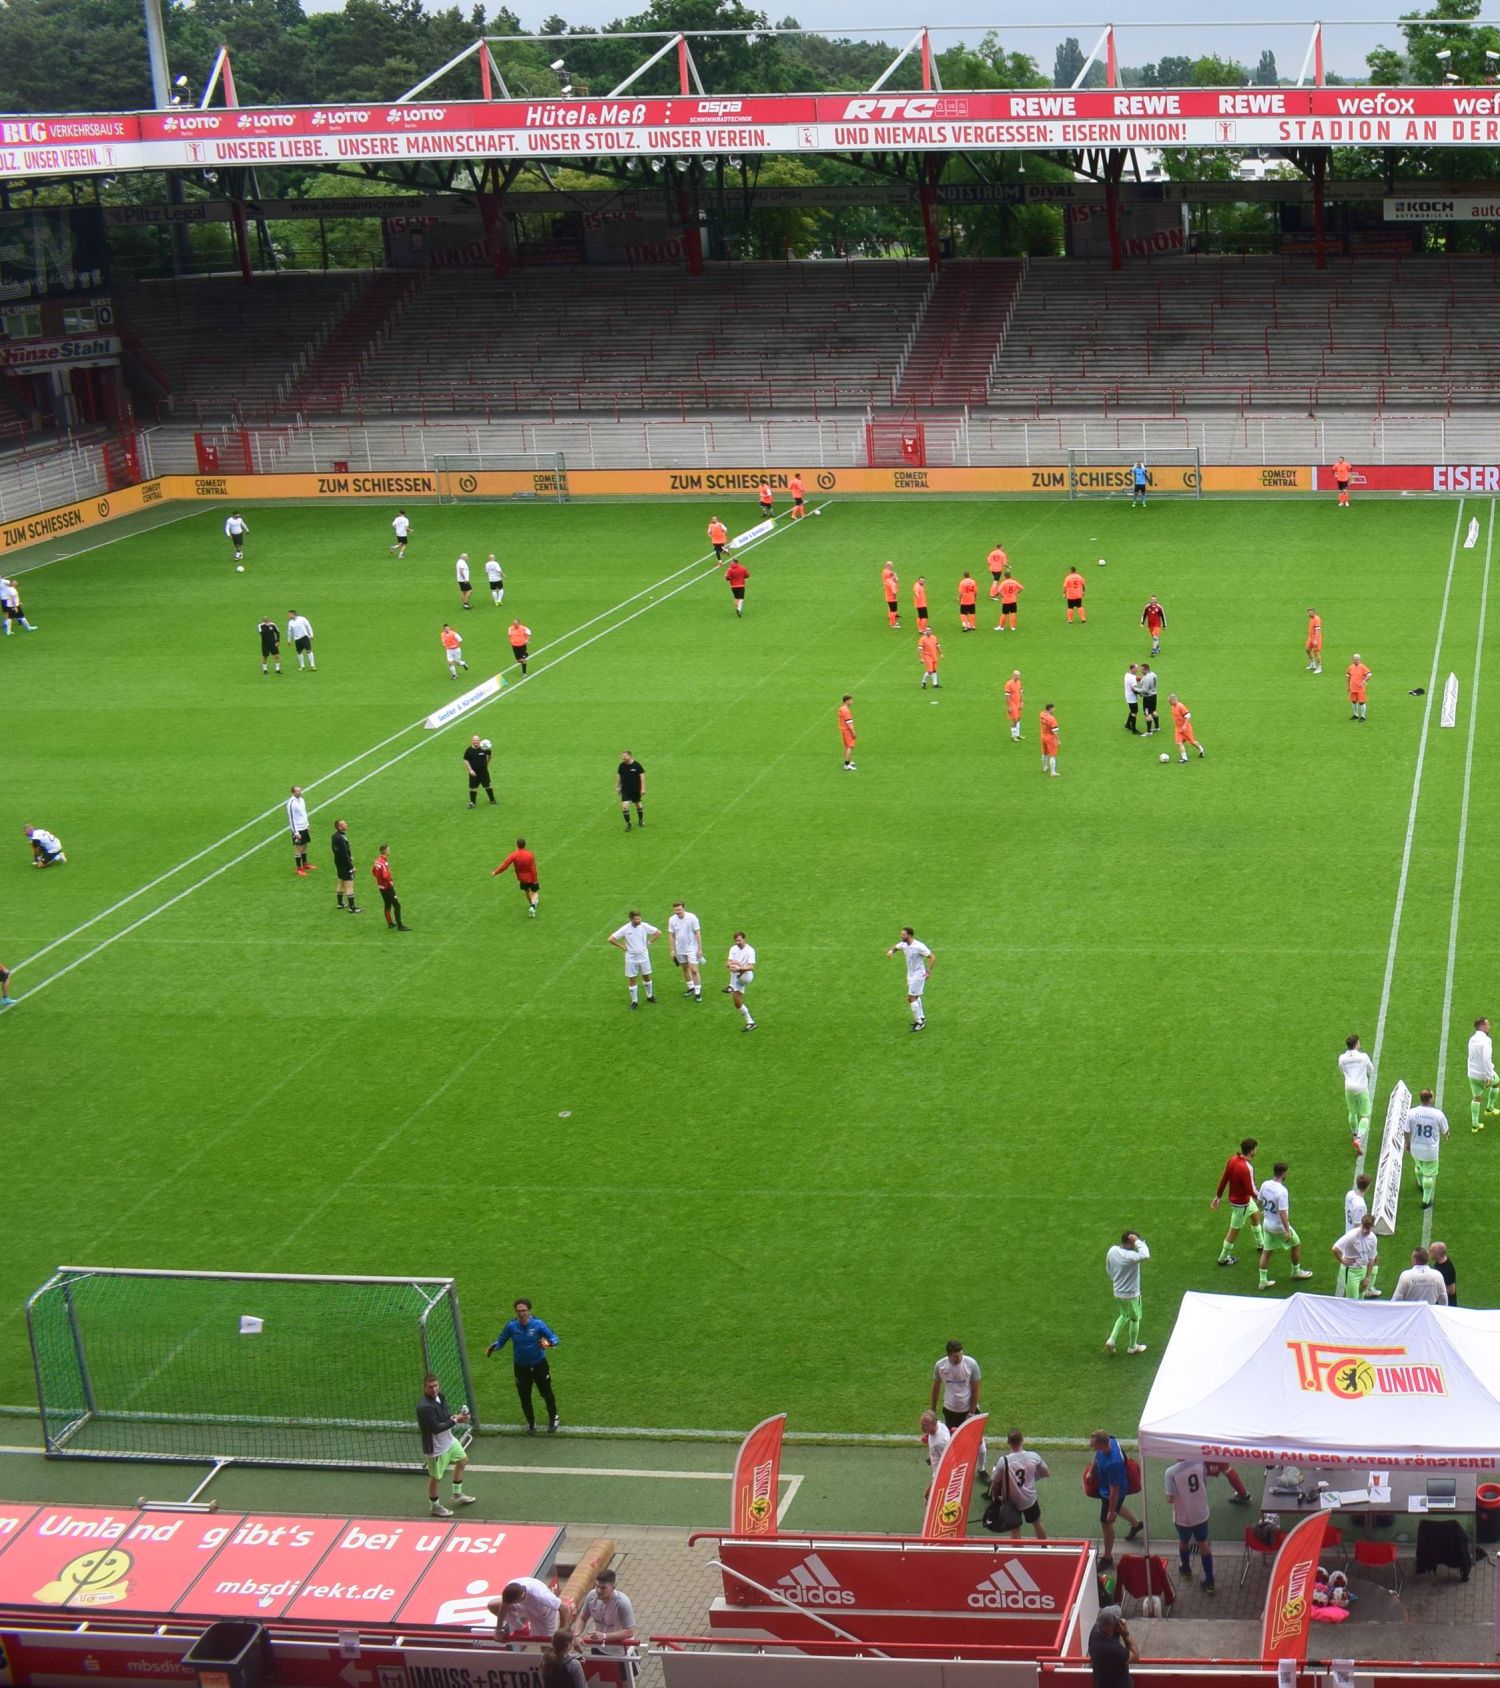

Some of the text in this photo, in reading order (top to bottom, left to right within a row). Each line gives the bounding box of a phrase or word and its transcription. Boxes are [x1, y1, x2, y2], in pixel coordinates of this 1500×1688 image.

[1010, 98, 1077, 117] REWE
[1114, 96, 1181, 115] REWE
[1219, 95, 1286, 115] REWE
[1337, 93, 1415, 115] wefox
[180, 117, 220, 130] LOTTO
[255, 114, 294, 128] LOTTO
[329, 111, 369, 125] LOTTO
[403, 108, 444, 122] LOTTO
[3, 122, 125, 144] BUG VERKEHRSBAU SE
[834, 123, 1188, 147] UND NIEMALS VERGESSEN: EISERN UNION!
[1279, 121, 1391, 141] STADION
[1405, 121, 1437, 140] AN
[1452, 121, 1499, 140] DER
[217, 129, 770, 161] UNSERE LIEBE. UNSERE MANNSCHAFT. UNSER STOLZ. UNSER VEREIN.
[24, 145, 101, 169] UNSER VEREIN.
[1407, 202, 1454, 212] KOCH
[671, 474, 702, 489] ZUM
[893, 471, 928, 480] COMEDY
[1032, 473, 1065, 487] ZUM
[1263, 469, 1297, 478] COMEDY
[1263, 478, 1298, 487] CENTRAL
[195, 480, 226, 488] COMEDY
[195, 487, 228, 496] CENTRAL
[318, 477, 437, 493] ZUM SCHIESSEN.
[894, 480, 930, 488] CENTRAL
[3, 508, 86, 547] ZUM SCHIESSEN.
[1416, 1123, 1433, 1138] 18
[1261, 1197, 1277, 1214] 22
[1376, 1366, 1445, 1394] UNION
[1200, 1444, 1274, 1460] STADION
[1347, 1455, 1400, 1465] ALTEN
[1015, 1468, 1025, 1487] 3
[1188, 1473, 1199, 1493] 9
[37, 1514, 185, 1542] Umland
[339, 1527, 404, 1551] bei
[415, 1533, 507, 1554] uns!
[215, 1579, 396, 1602] mbsdirekt.de
[769, 1585, 856, 1606] adidas
[967, 1587, 1056, 1610] adidas
